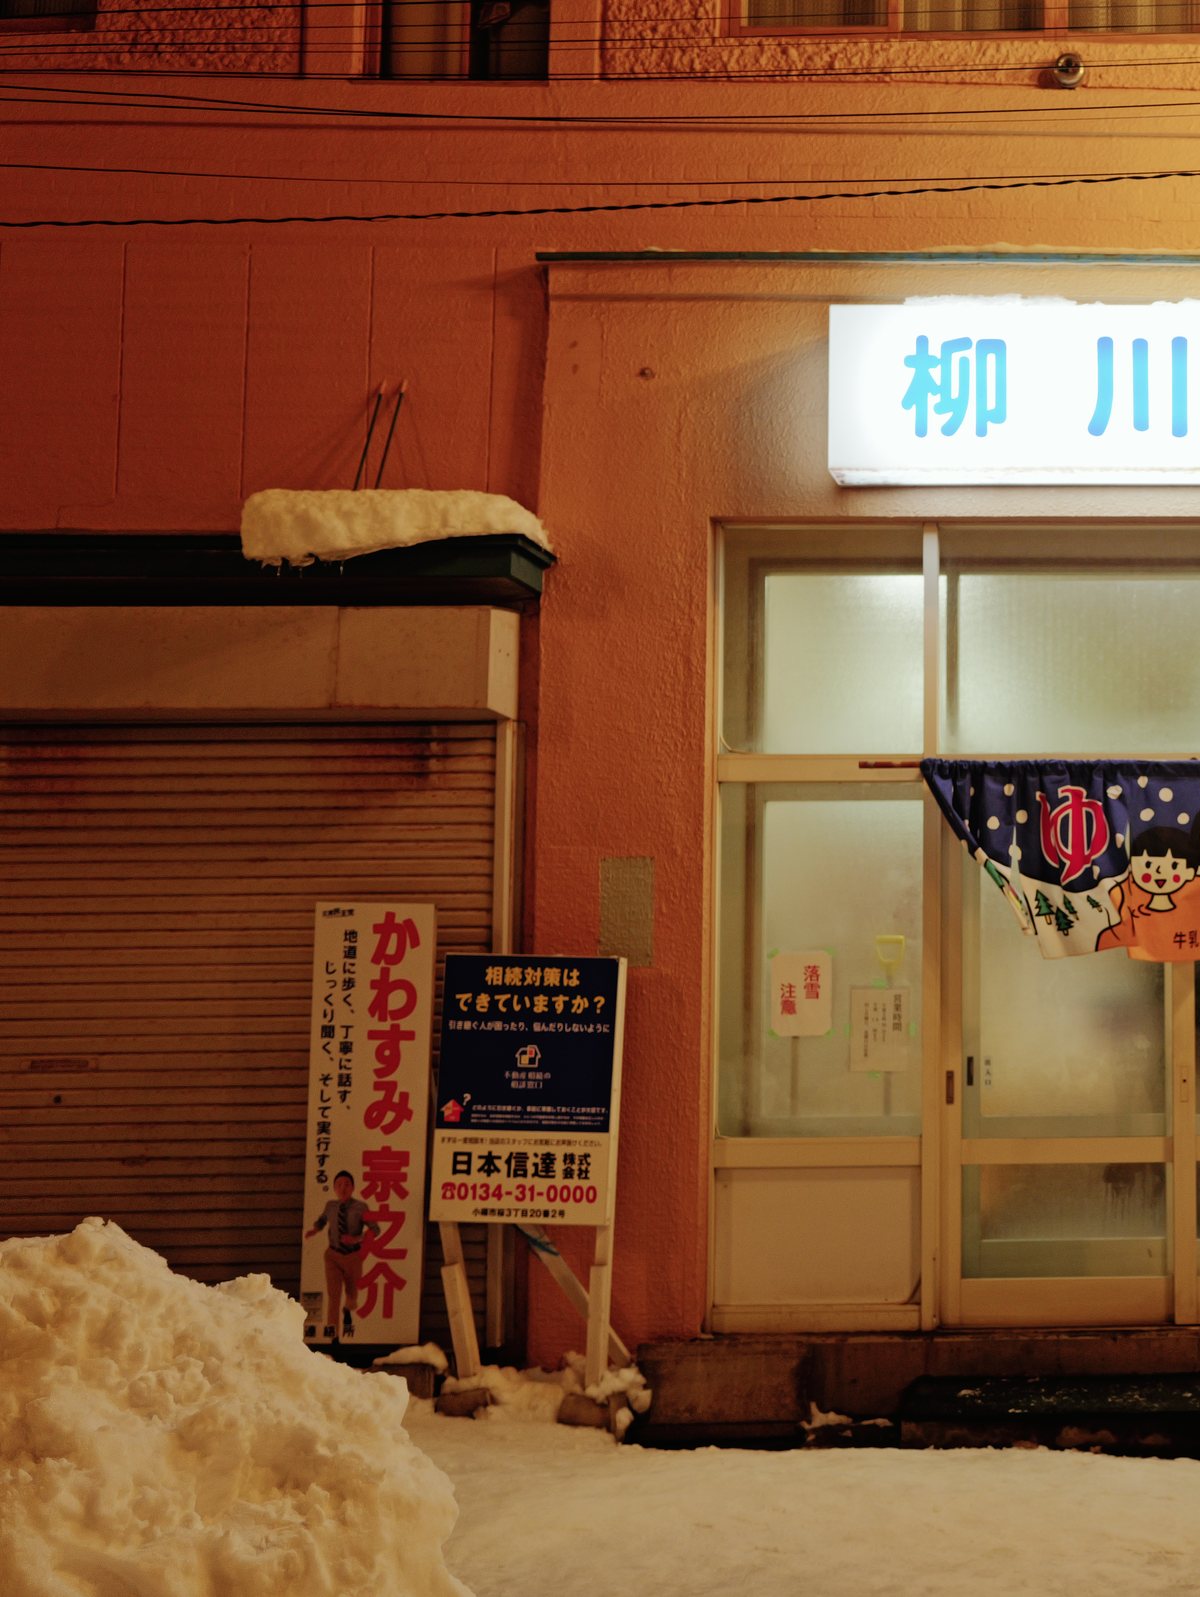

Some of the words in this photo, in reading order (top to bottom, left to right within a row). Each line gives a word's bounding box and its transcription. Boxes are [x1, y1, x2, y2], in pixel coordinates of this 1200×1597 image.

[1036, 785, 1111, 886] ゆ
[485, 965, 581, 987] 相続対策は
[803, 965, 820, 999] 落雪
[780, 983, 797, 1015] 注意
[363, 911, 420, 1135] かわすみ
[452, 1151, 556, 1178] 日本信達
[356, 1146, 410, 1319] 宗之介
